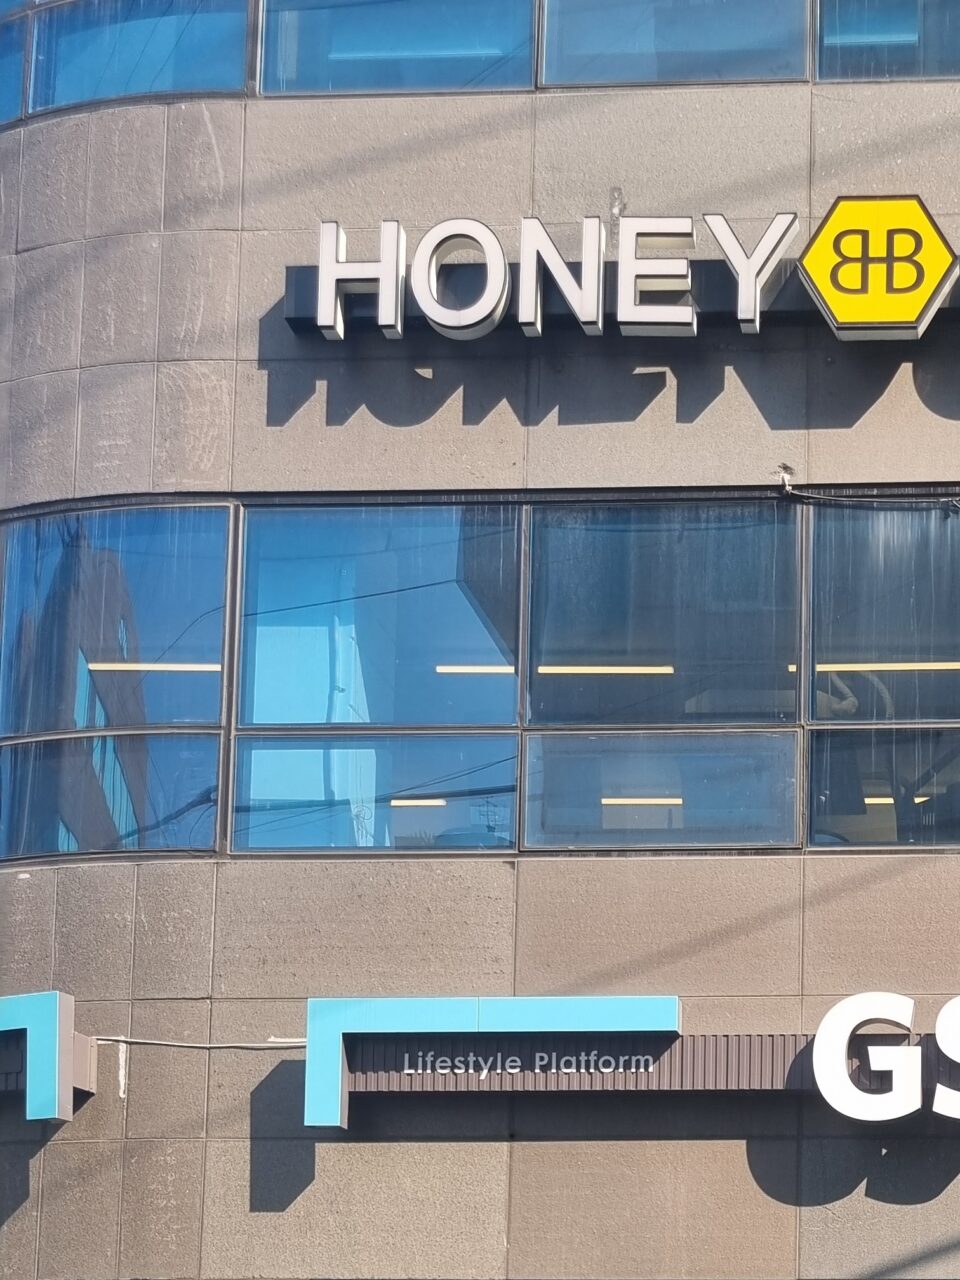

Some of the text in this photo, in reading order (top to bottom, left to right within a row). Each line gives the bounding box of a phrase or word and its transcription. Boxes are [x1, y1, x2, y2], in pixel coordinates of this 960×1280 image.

[316, 212, 800, 337] HONEY
[403, 1050, 654, 1079] Lifestyle Platform
